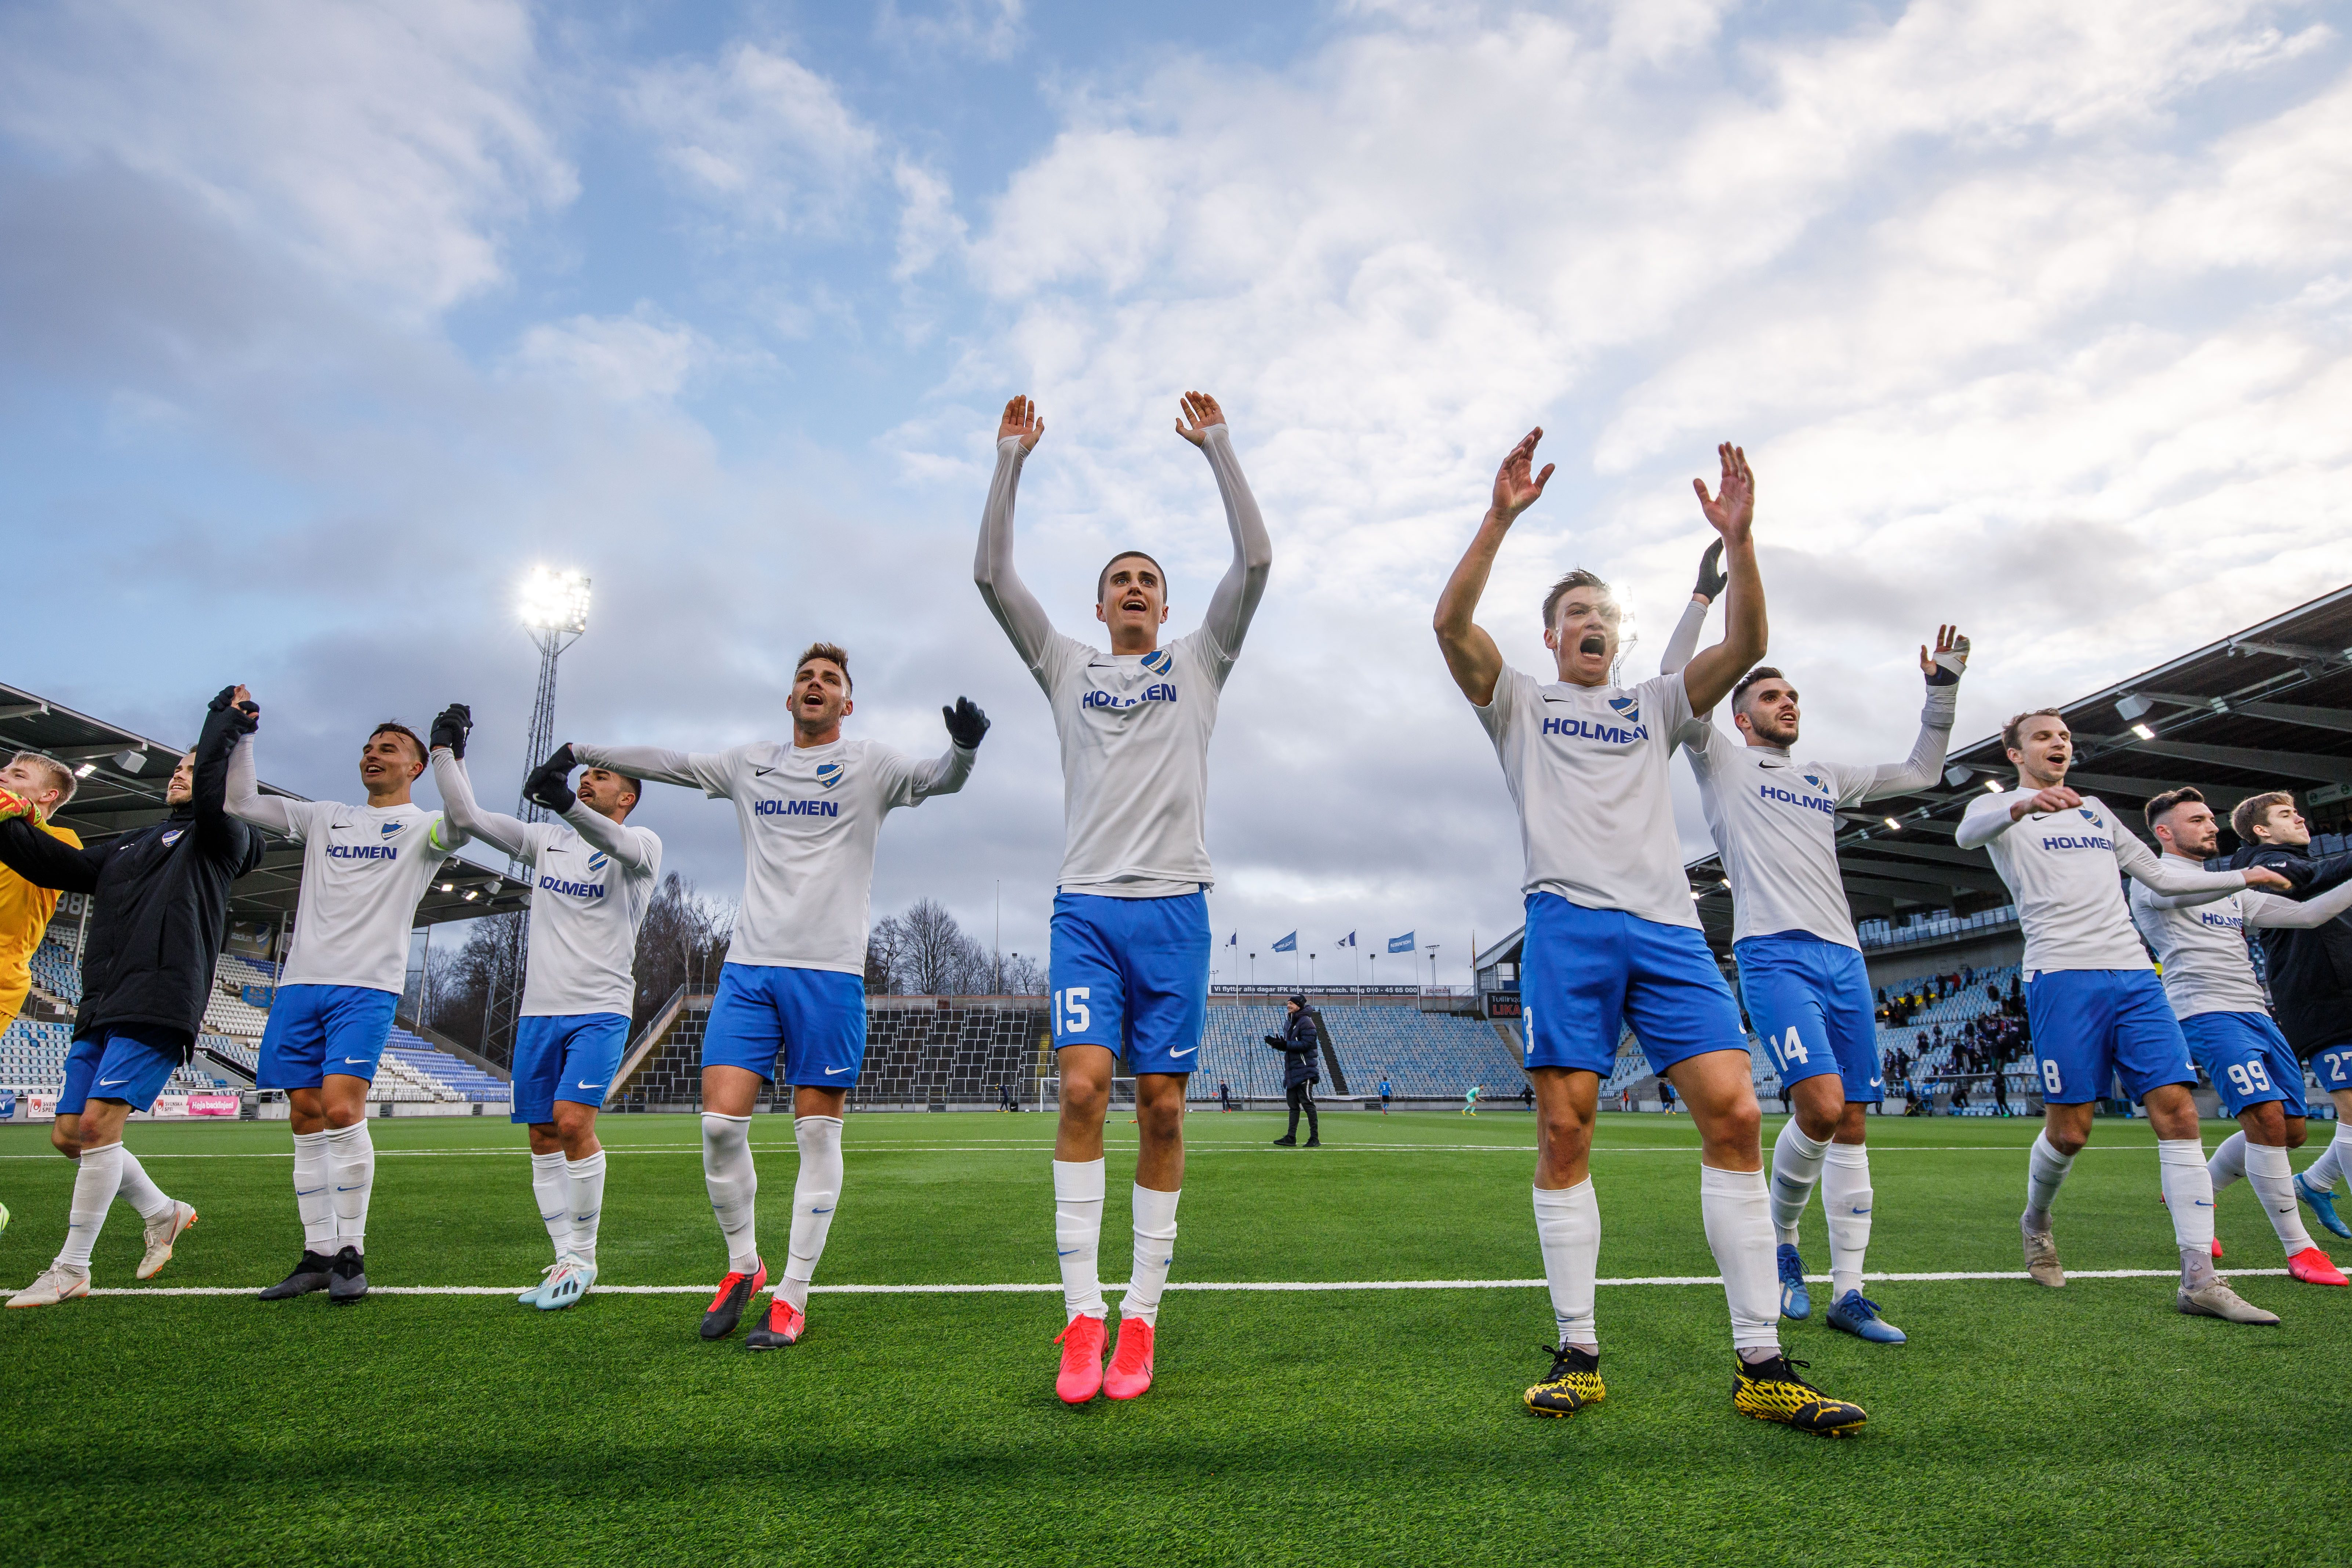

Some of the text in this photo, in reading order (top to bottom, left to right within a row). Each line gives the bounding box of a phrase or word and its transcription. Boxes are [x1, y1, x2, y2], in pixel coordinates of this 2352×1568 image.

[1151, 653, 1168, 669] NORRKÖPING
[1543, 718, 1649, 744] HOLMEN
[820, 768, 843, 780] NORRKÖPING
[755, 800, 838, 817] HOLMEN
[1761, 785, 1835, 816] HOLME
[384, 827, 405, 837] NORRKÖPING
[325, 845, 397, 859] HOLMEN
[2043, 837, 2115, 852] HOLMEN
[1390, 939, 1411, 948] HOLMEN
[1055, 987, 1090, 1036] 15
[1493, 1005, 1522, 1015] LIKA
[1770, 1026, 1808, 1072] 14
[2043, 1060, 2062, 1093] 8
[2228, 1061, 2270, 1095] 99
[192, 1101, 234, 1110] Heja backlinjen!
